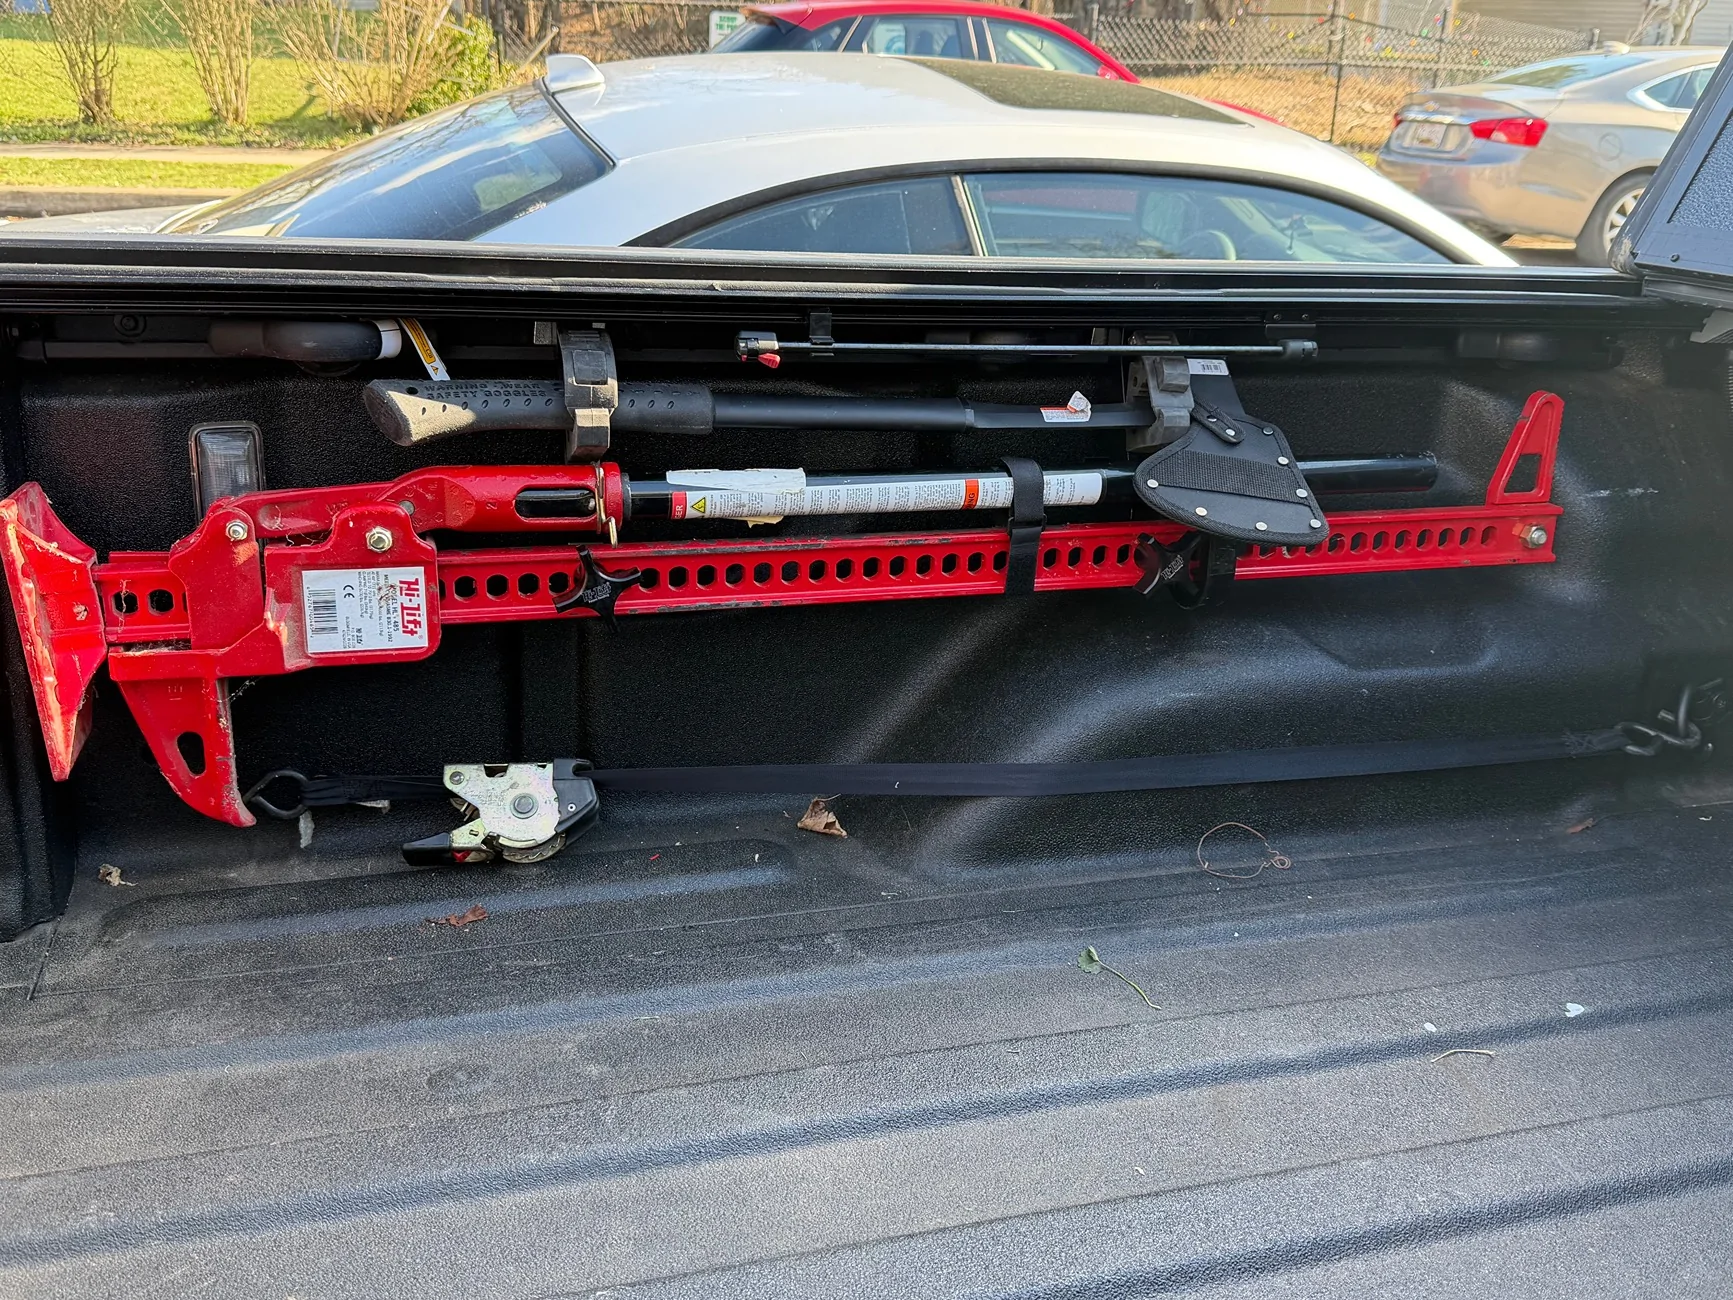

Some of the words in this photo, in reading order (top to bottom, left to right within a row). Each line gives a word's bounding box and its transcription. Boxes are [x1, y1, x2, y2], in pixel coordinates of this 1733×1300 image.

[424, 383, 488, 392] WARNING
[426, 389, 478, 400] SAFETY
[484, 389, 547, 398] GOGGLES
